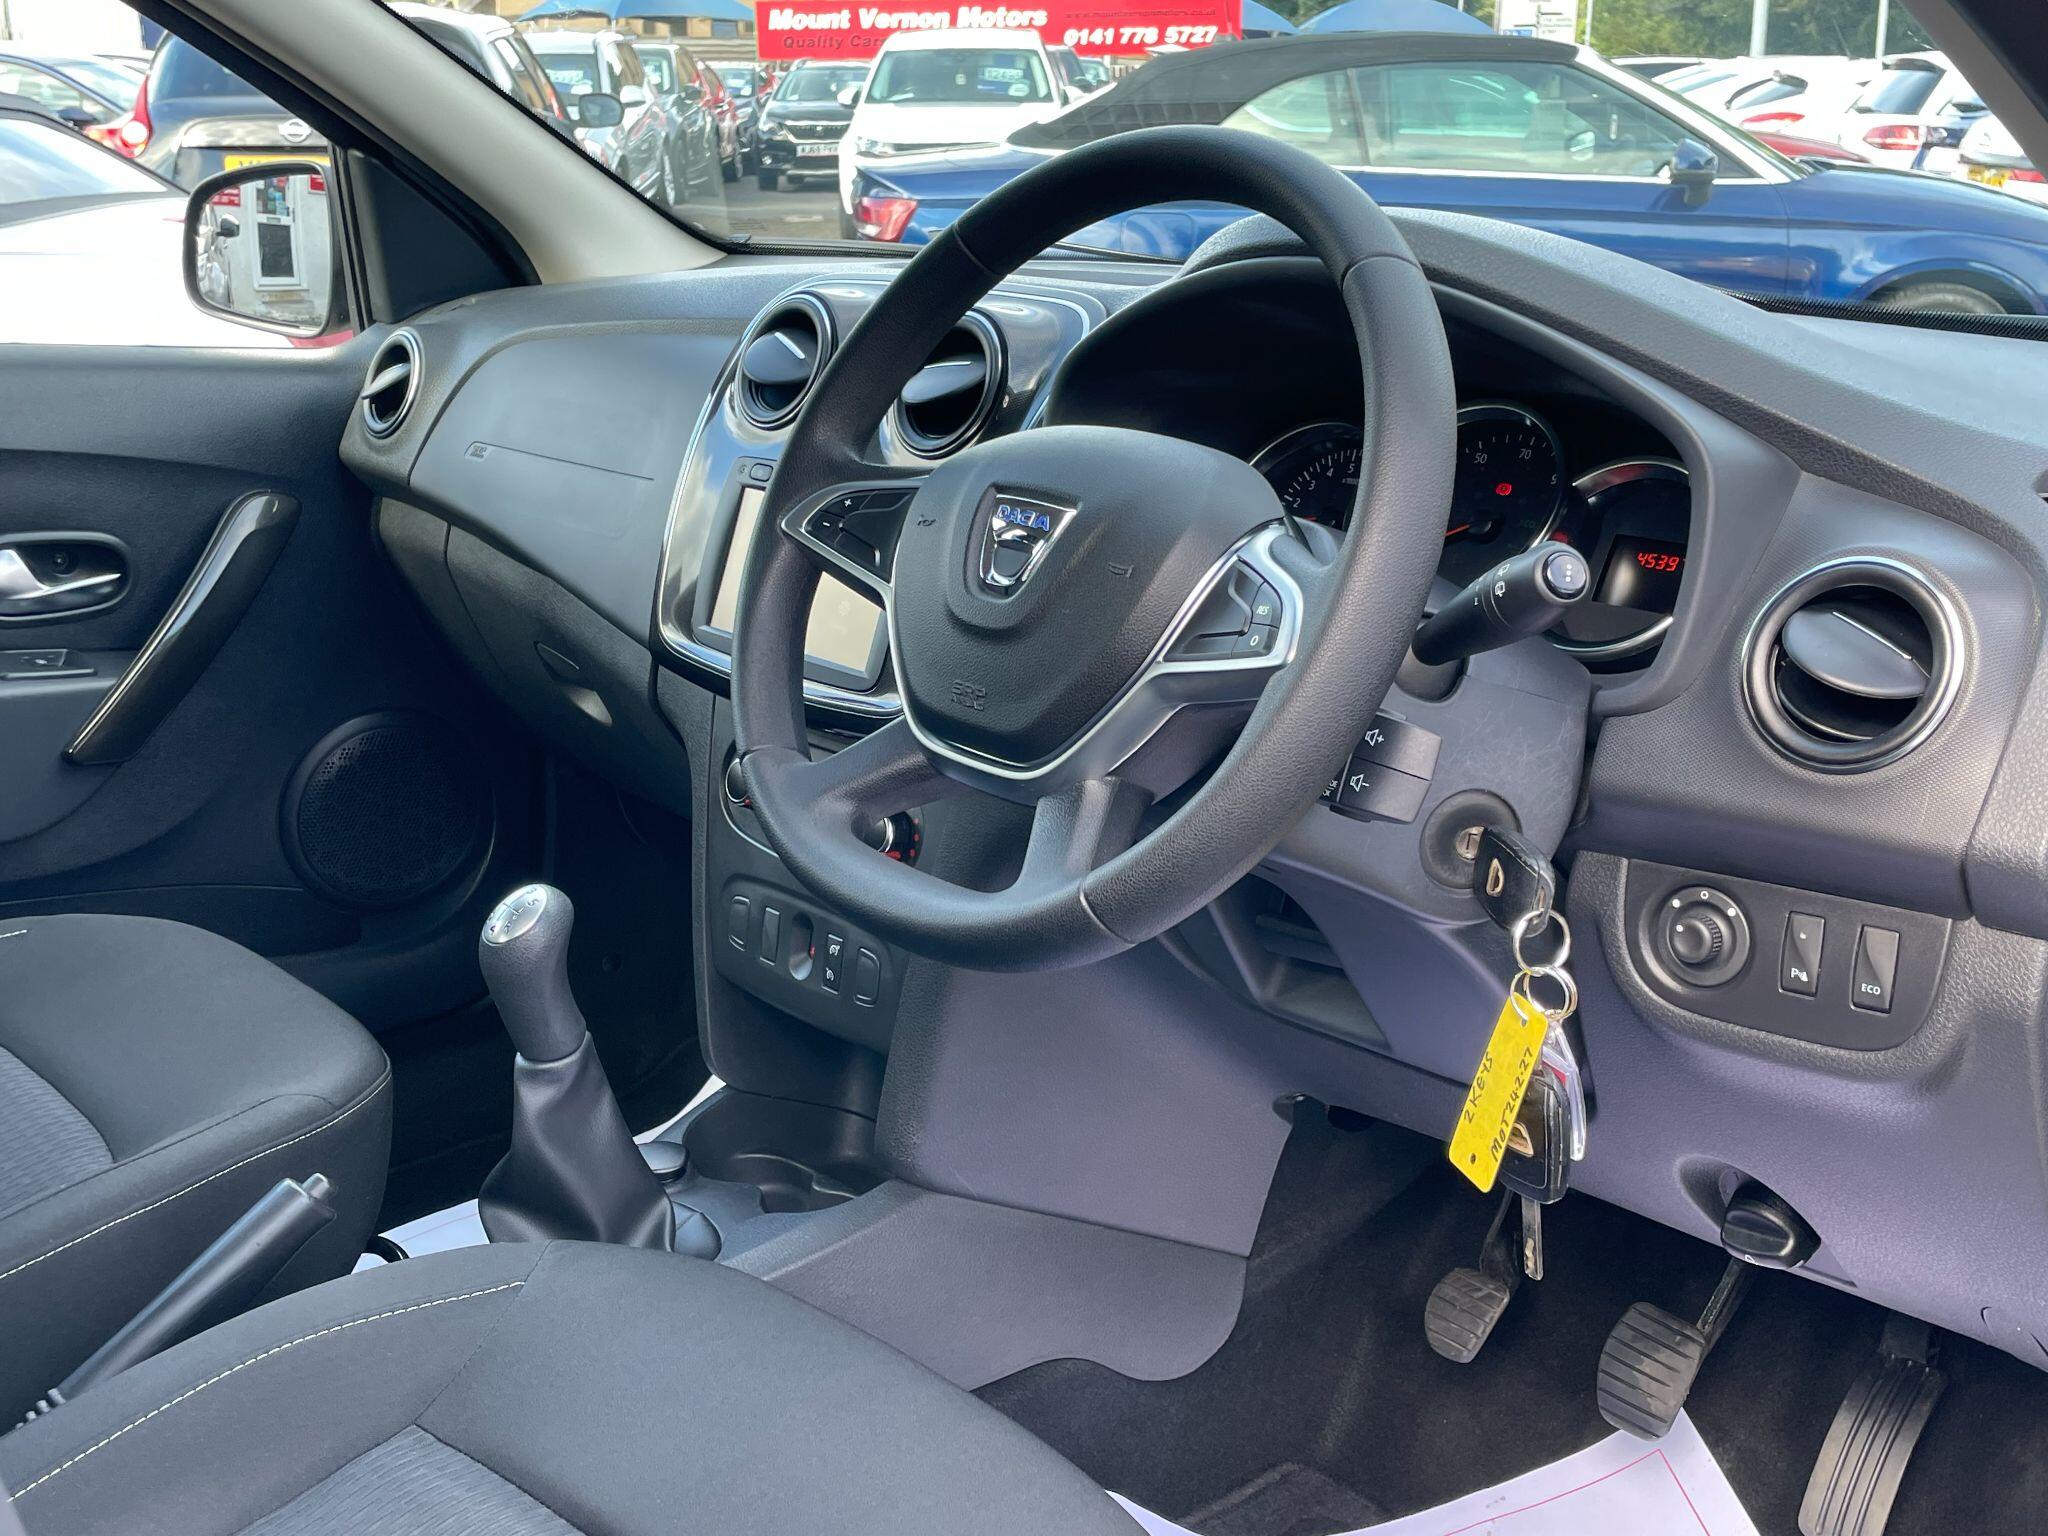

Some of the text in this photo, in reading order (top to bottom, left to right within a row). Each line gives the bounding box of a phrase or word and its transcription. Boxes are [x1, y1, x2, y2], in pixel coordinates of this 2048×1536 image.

[768, 6, 1048, 30] Mount Vernon Motors
[784, 35, 844, 49] Quality
[1063, 27, 1115, 47] 0141
[1164, 25, 1218, 44] 5727
[1473, 453, 1488, 464] 50
[1519, 448, 1532, 460] 70
[1326, 467, 1334, 477] 4
[1347, 463, 1355, 474] 5
[1308, 480, 1316, 491] 3
[1293, 498, 1301, 508] 2
[996, 504, 1050, 532] DACIA
[1637, 552, 1680, 572] 4539
[1256, 605, 1269, 615] RES
[1860, 983, 1881, 996] ECO
[1464, 1110, 1475, 1124] 2
